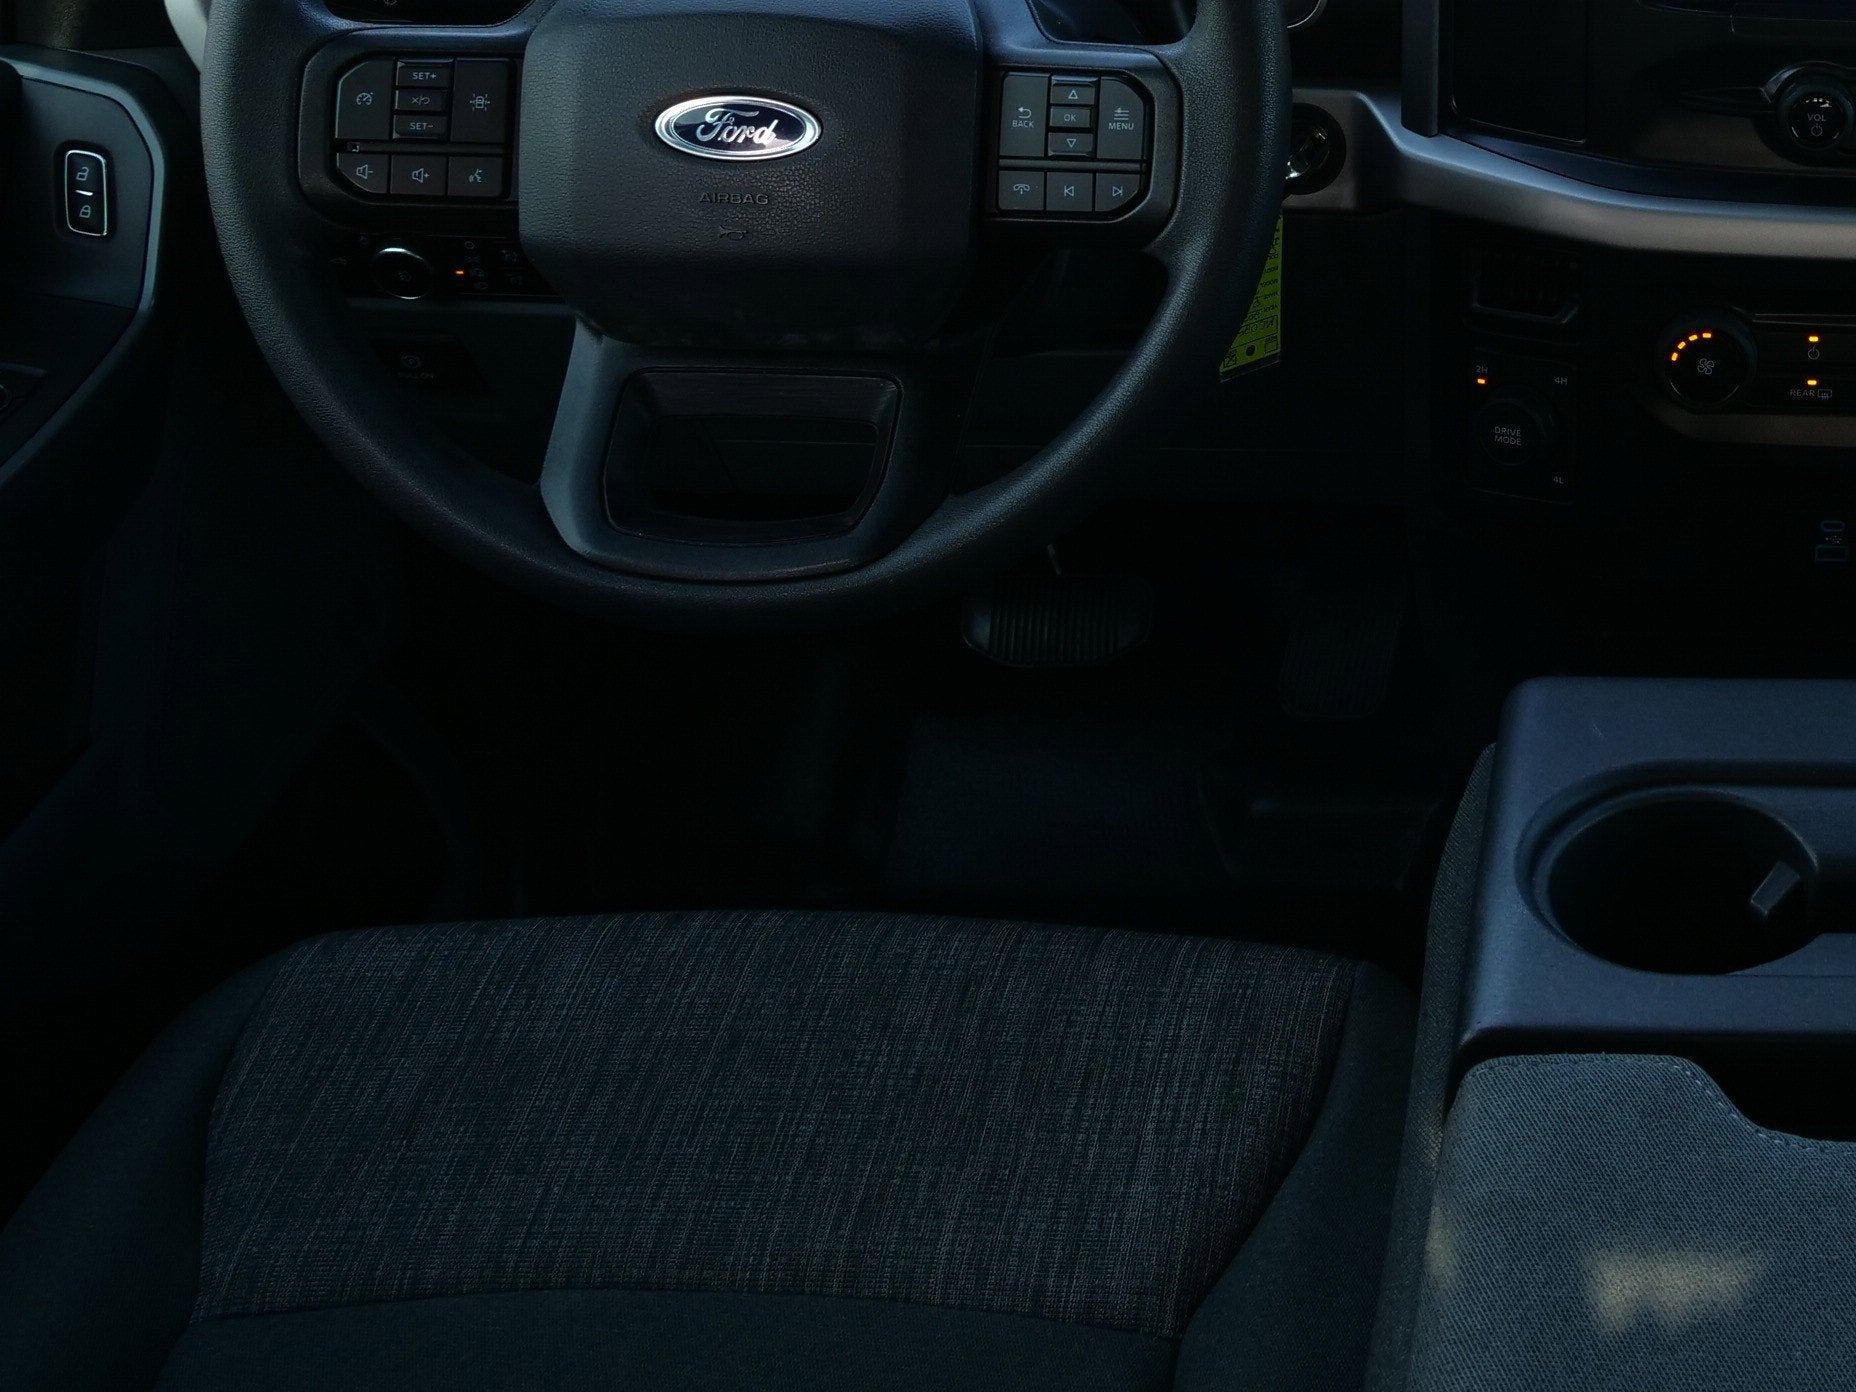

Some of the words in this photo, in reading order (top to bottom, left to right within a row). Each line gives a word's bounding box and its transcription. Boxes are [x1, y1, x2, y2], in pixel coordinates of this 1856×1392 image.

[1063, 114, 1077, 122] OK
[1807, 113, 1827, 122] VOL
[696, 108, 777, 145] Ford
[1011, 120, 1035, 129] BACK
[1108, 122, 1135, 131] MENU
[699, 192, 769, 205] AIRBAG
[1475, 364, 1488, 374] 2H
[1554, 376, 1568, 385] 4H
[1789, 388, 1816, 397] REAR
[1494, 426, 1521, 437] DRIVE
[1494, 436, 1522, 446] MODE
[1552, 475, 1564, 485] 4L
